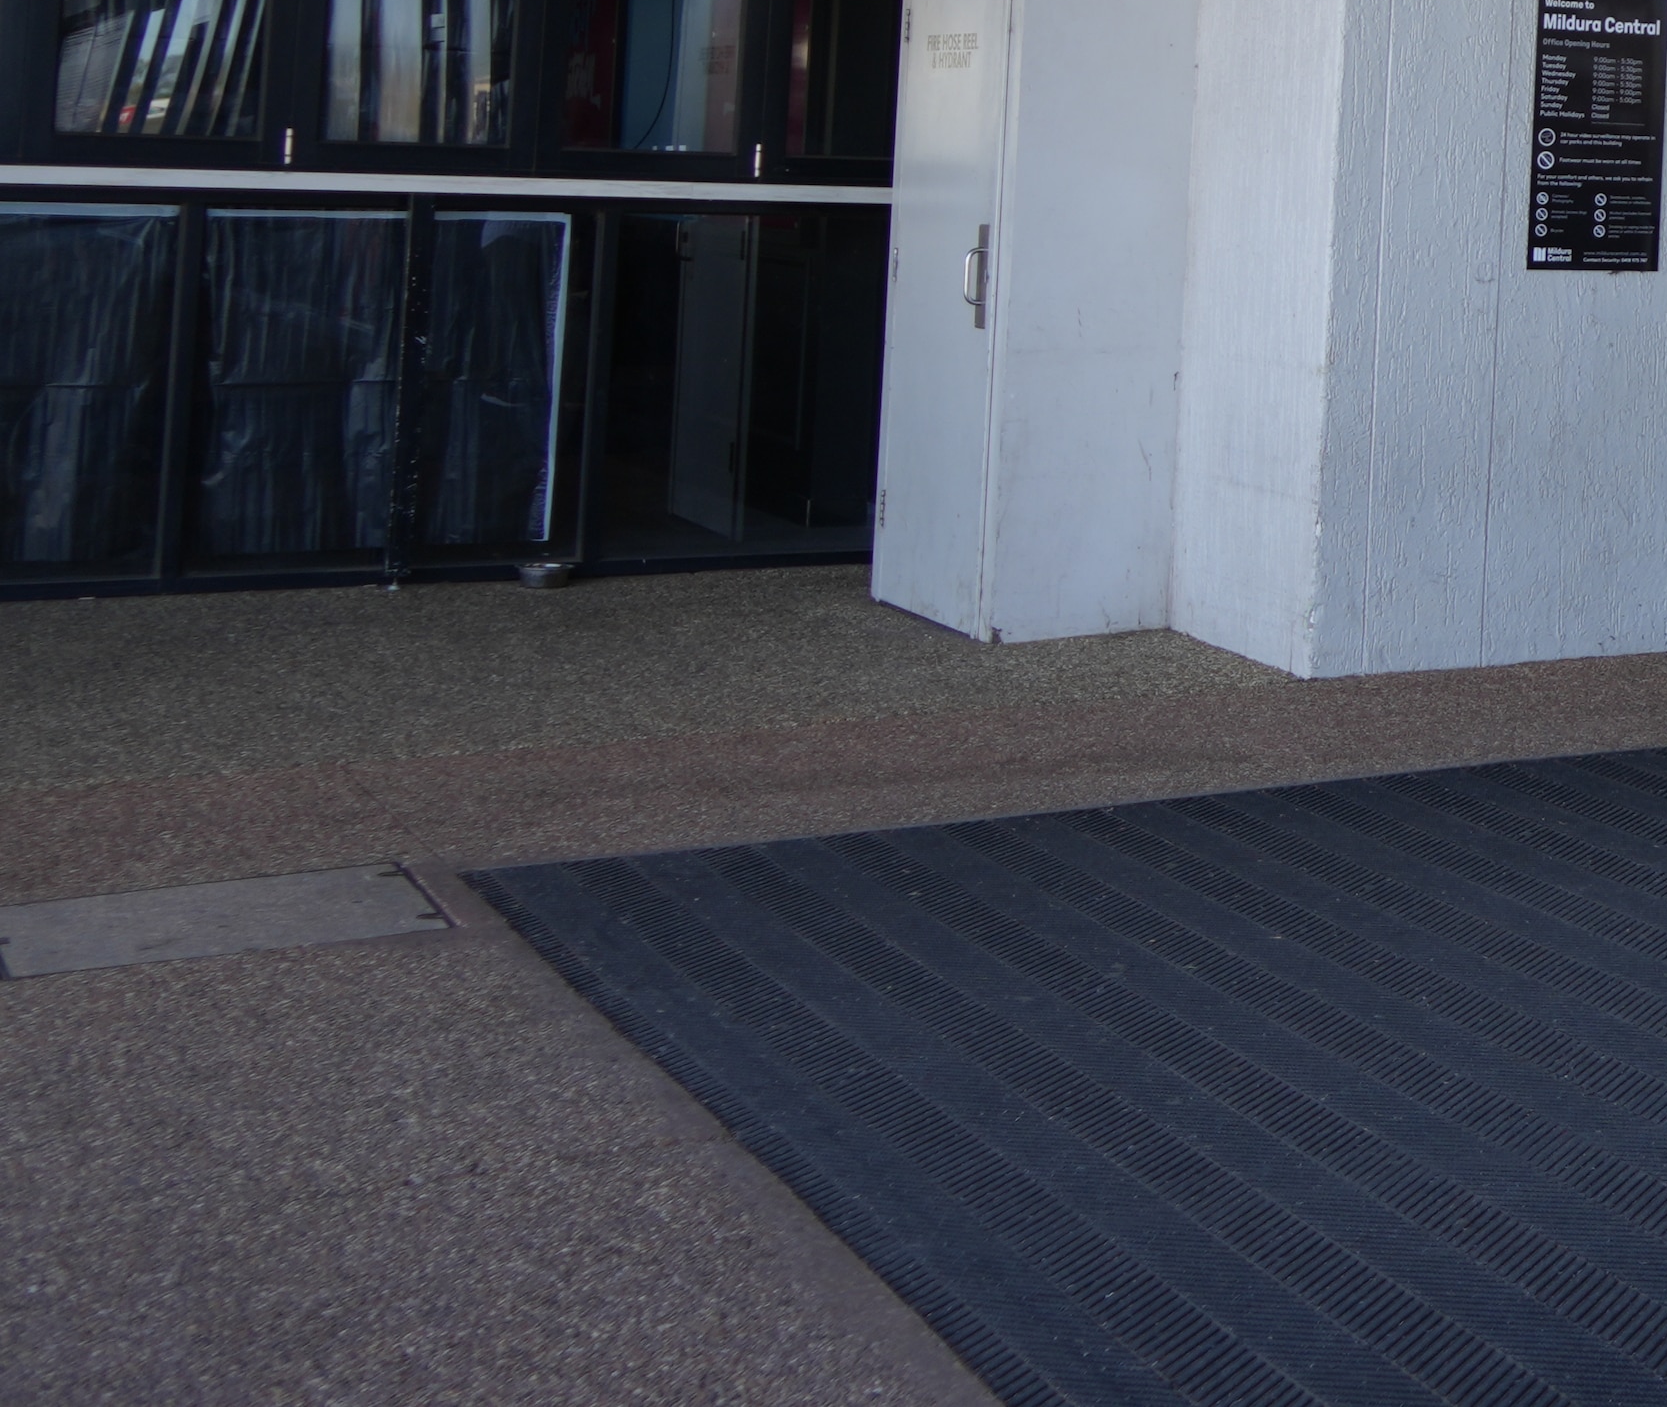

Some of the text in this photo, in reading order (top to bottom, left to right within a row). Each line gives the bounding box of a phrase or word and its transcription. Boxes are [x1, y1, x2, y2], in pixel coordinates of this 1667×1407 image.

[1584, 0, 1595, 10] to
[1543, 13, 1660, 35] Mildura Central
[927, 33, 979, 51] FIRE HOSE REEL
[1543, 38, 1610, 49] Office Opening Hours
[939, 51, 972, 68] HYDRANT
[1542, 54, 1567, 63] Monday
[1542, 62, 1566, 70] Tuesday
[1542, 70, 1576, 79] Wednesday
[1542, 78, 1569, 86] Thursday
[1541, 93, 1568, 102] Saturday
[1541, 101, 1563, 109] Sunday
[1560, 111, 1585, 119] Holidays
[1547, 254, 1572, 262] Central
